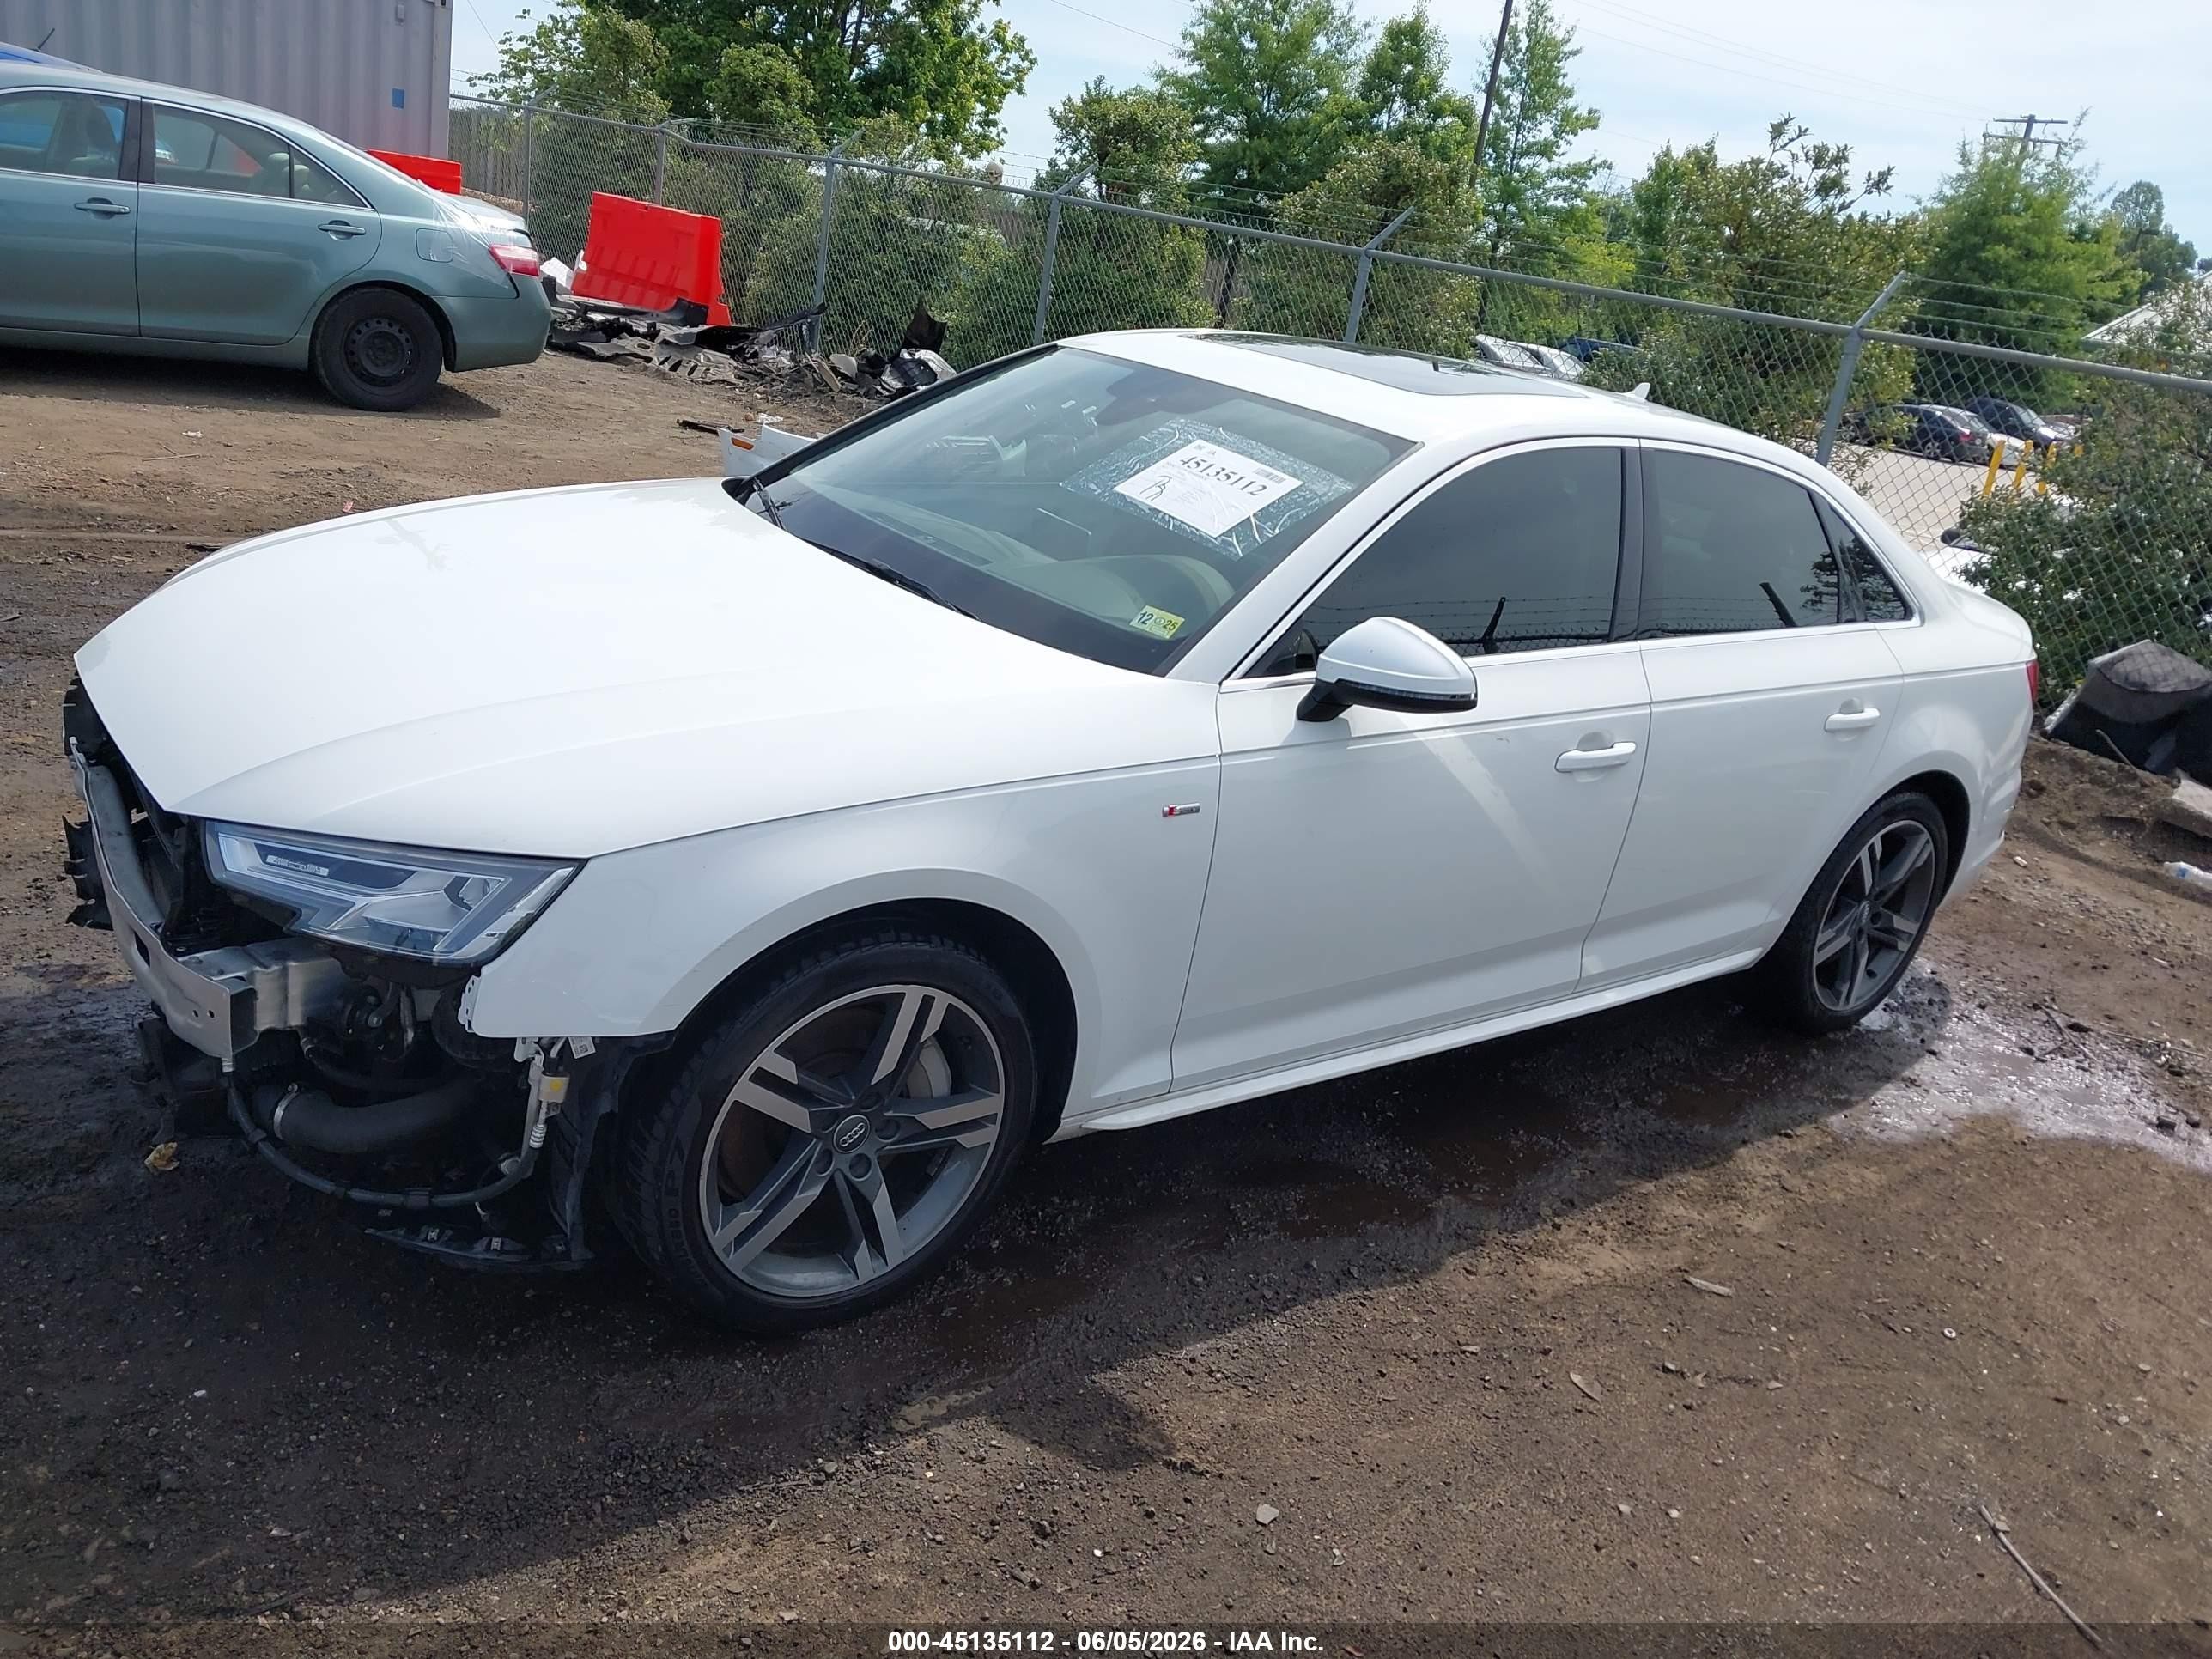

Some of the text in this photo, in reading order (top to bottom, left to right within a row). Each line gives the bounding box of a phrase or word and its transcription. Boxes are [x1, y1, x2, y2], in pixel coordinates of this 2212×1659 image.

[1180, 456, 1267, 496] 45135112
[1138, 611, 1179, 631] 12 25
